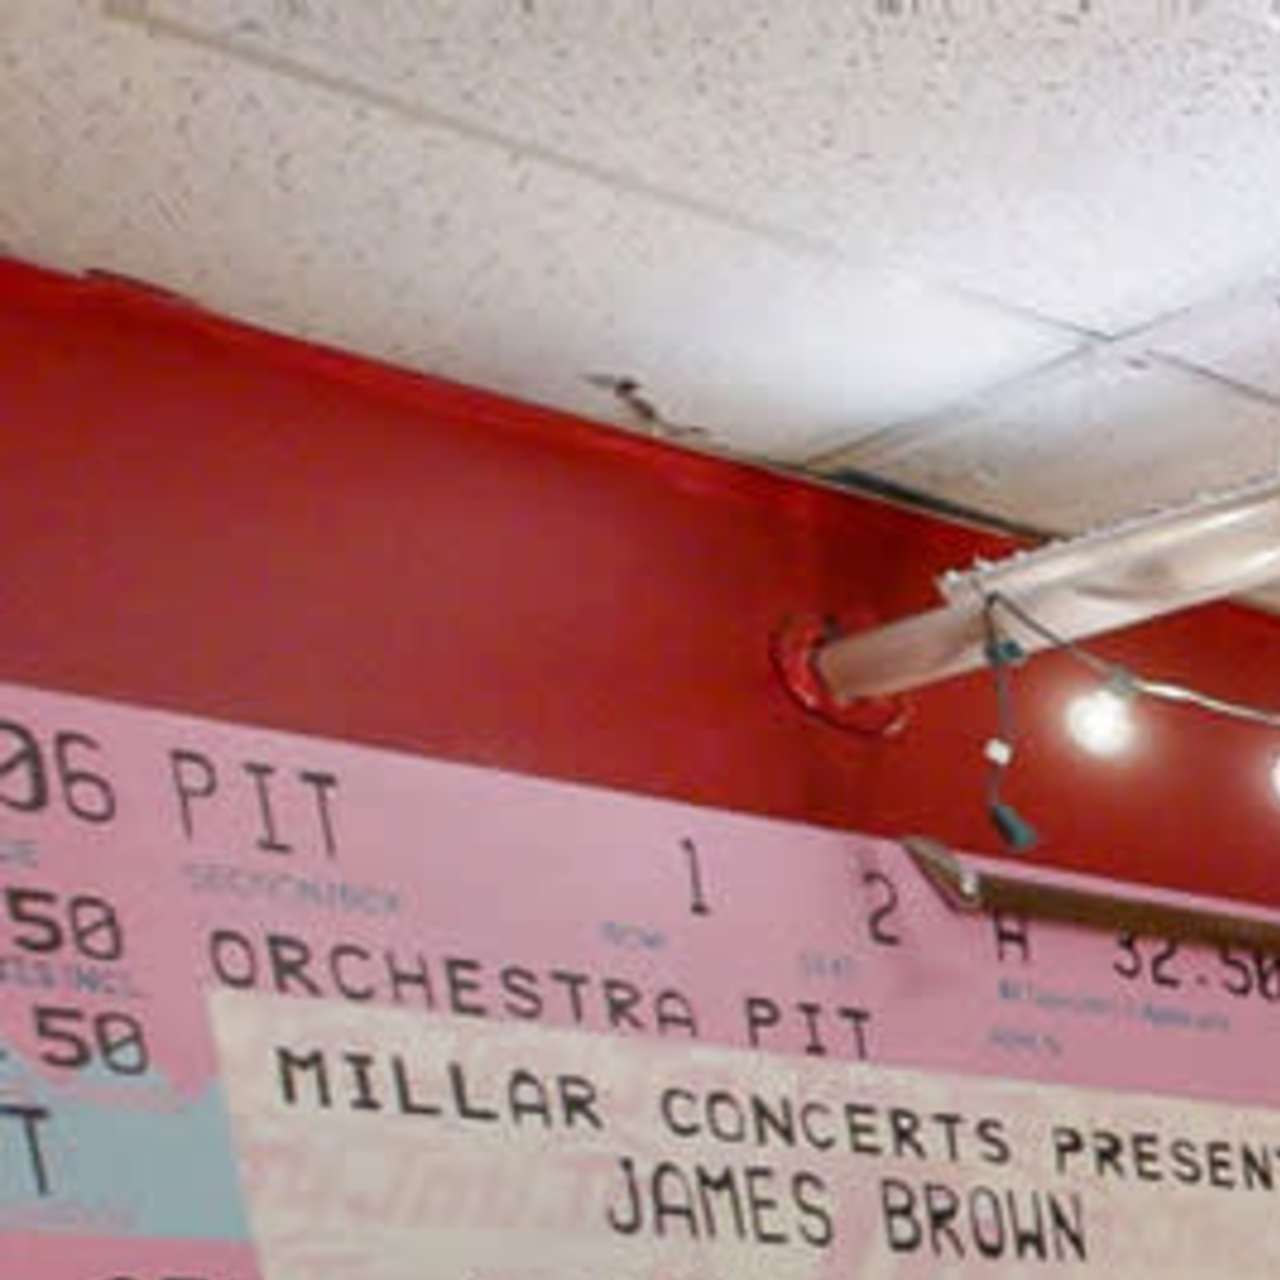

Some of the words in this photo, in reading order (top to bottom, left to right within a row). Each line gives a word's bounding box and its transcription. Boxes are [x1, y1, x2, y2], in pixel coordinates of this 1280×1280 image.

[168, 748, 340, 860] PIT
[680, 836, 712, 918] 1
[862, 870, 902, 948] 2
[208, 928, 698, 1036] ORCHESTRA
[744, 994, 872, 1062] PIT
[274, 1048, 606, 1132] MILLAR
[660, 1082, 1012, 1166] CONCERTS
[606, 1156, 836, 1250] JAMES
[882, 1178, 1088, 1264] BROWN
